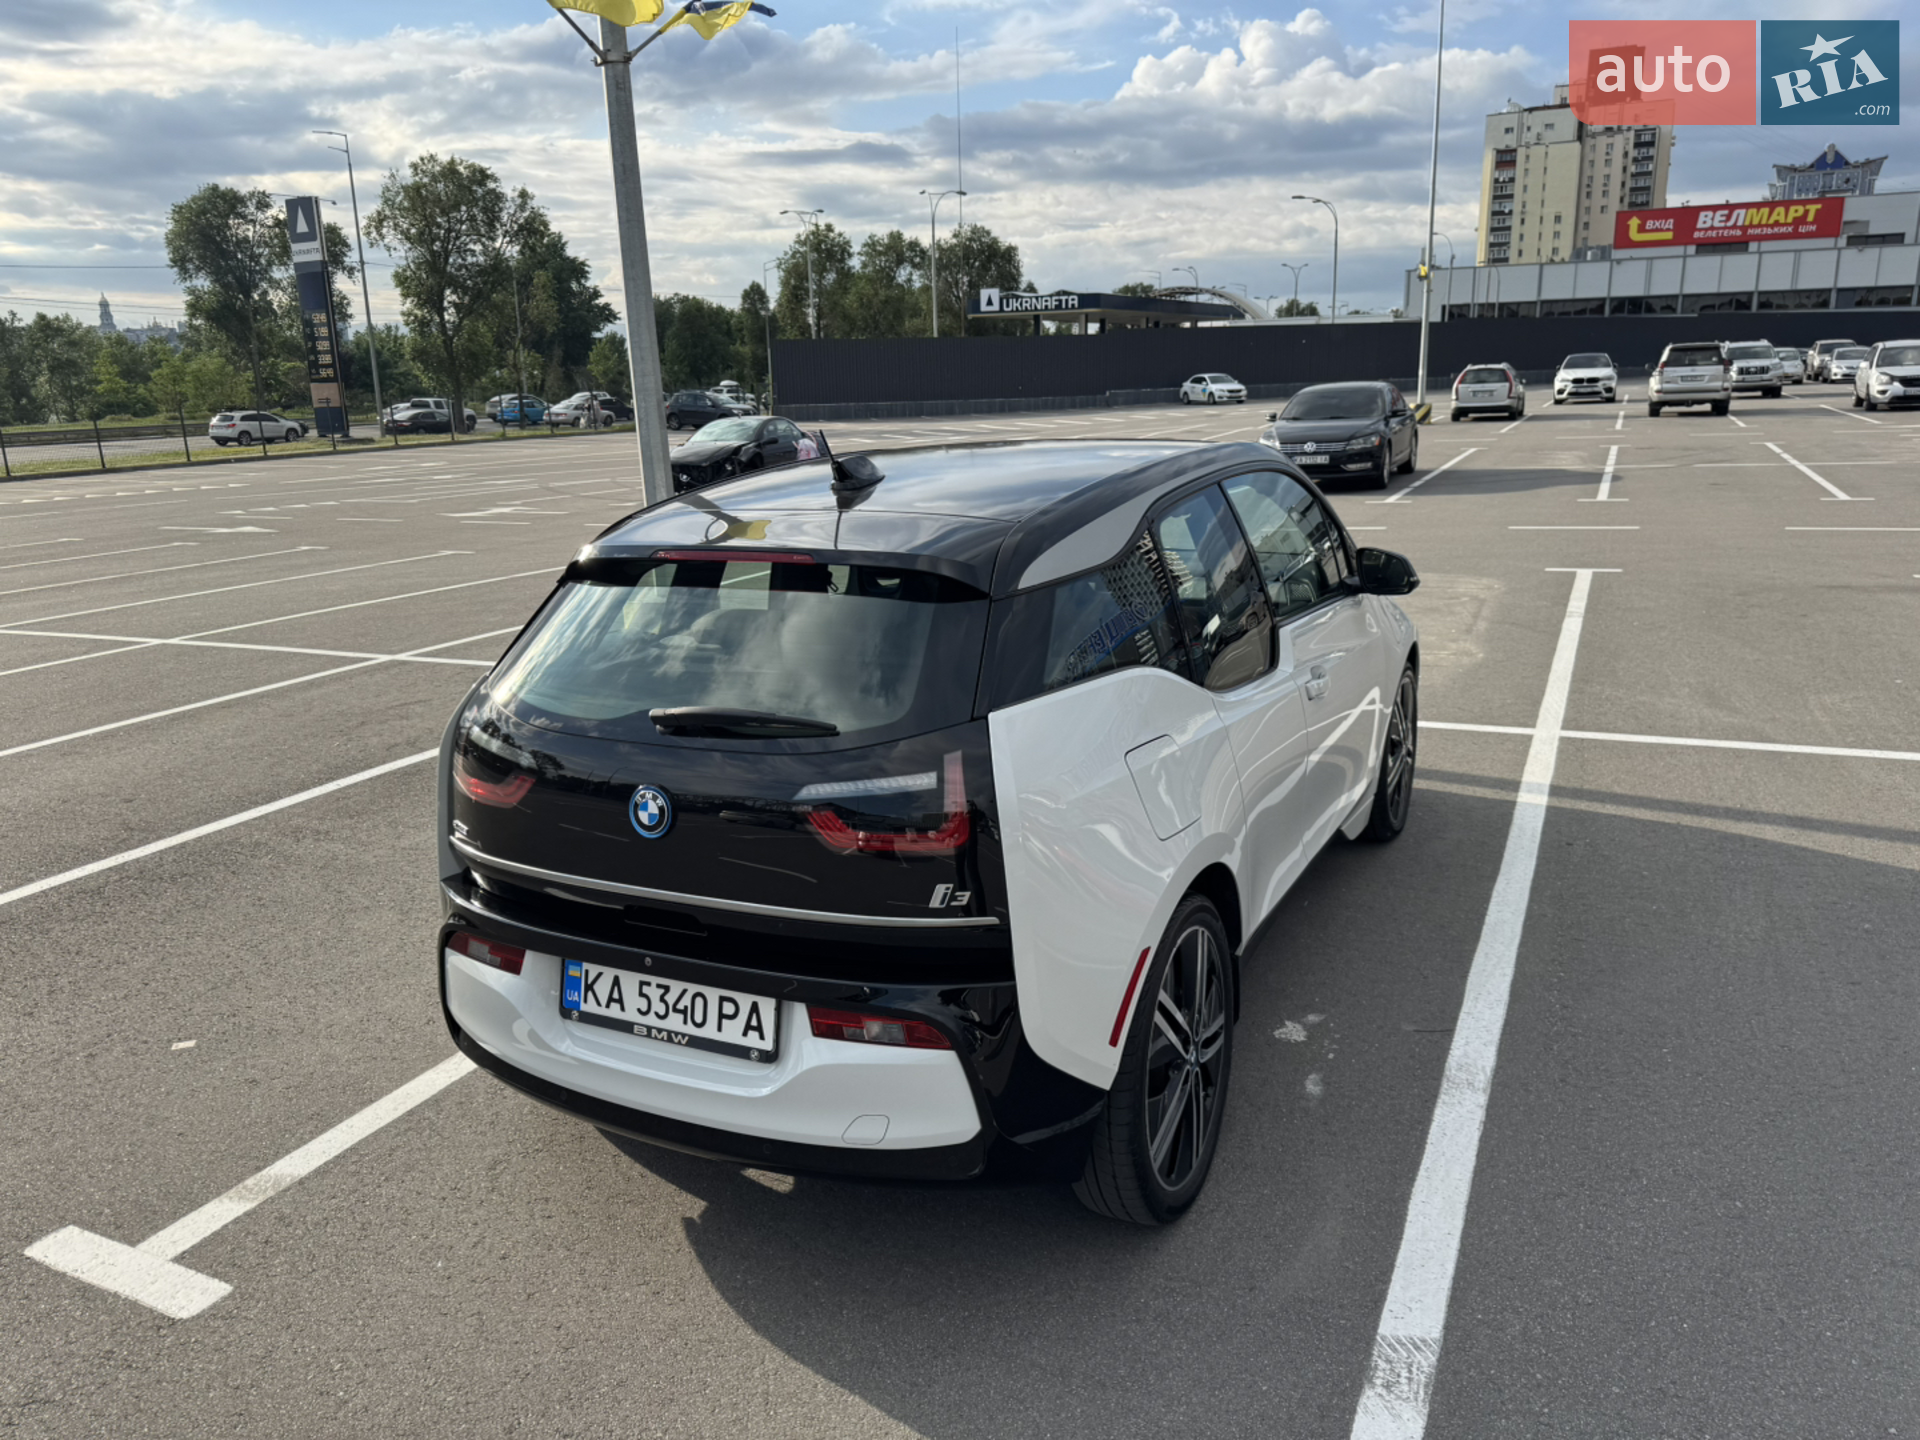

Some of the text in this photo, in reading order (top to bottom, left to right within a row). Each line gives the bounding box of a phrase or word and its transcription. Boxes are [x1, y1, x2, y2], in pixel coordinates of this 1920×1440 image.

[1645, 218, 1674, 230] ВХІД
[1696, 204, 1822, 229] ВЕЛМАРТ
[1693, 224, 1817, 238] ВЕЛЕТЕНЬ НИЗЬКИХ ЦІН
[1003, 295, 1079, 312] UKRNAFTA
[929, 883, 971, 908] i3
[566, 989, 580, 1002] UA
[583, 968, 765, 1041] KA 5340 PA
[633, 1024, 689, 1045] BMW
